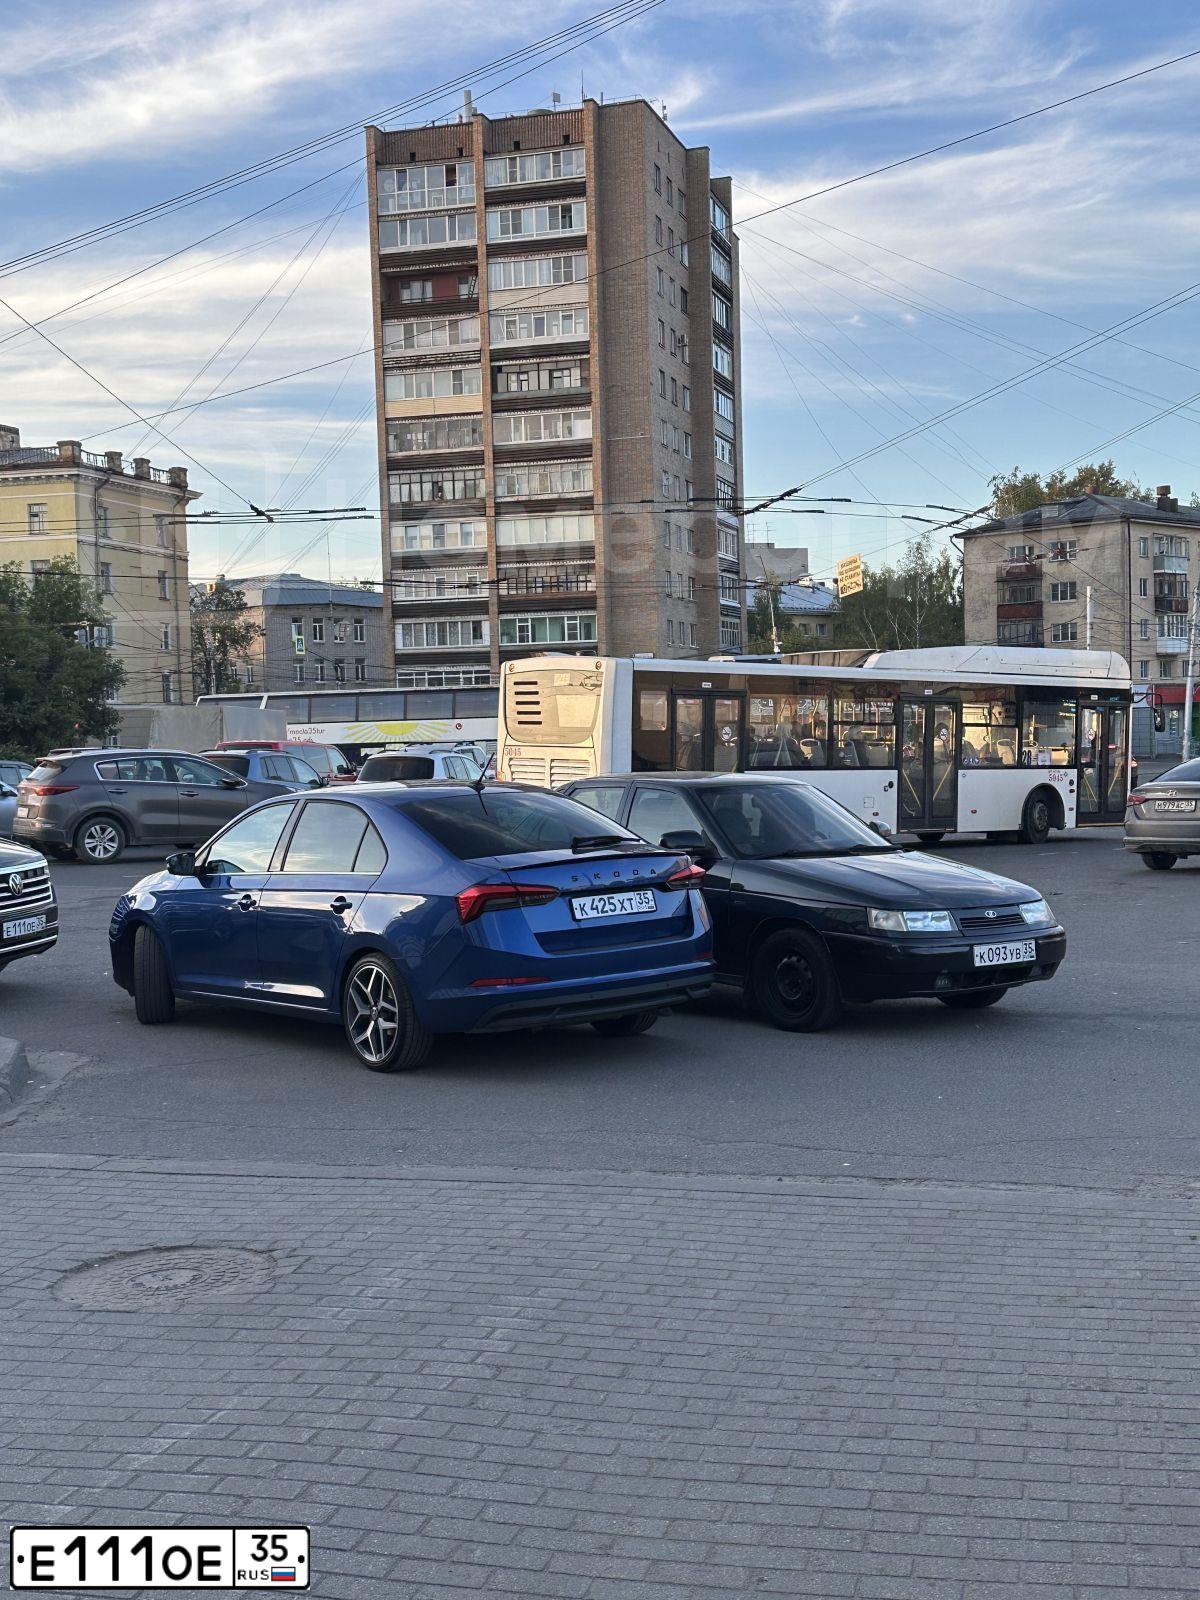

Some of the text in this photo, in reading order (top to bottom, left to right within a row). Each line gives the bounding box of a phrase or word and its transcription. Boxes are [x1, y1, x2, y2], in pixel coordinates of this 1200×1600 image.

[571, 869, 657, 882] SKODA
[635, 892, 650, 906] 35
[1023, 942, 1033, 955] 35
